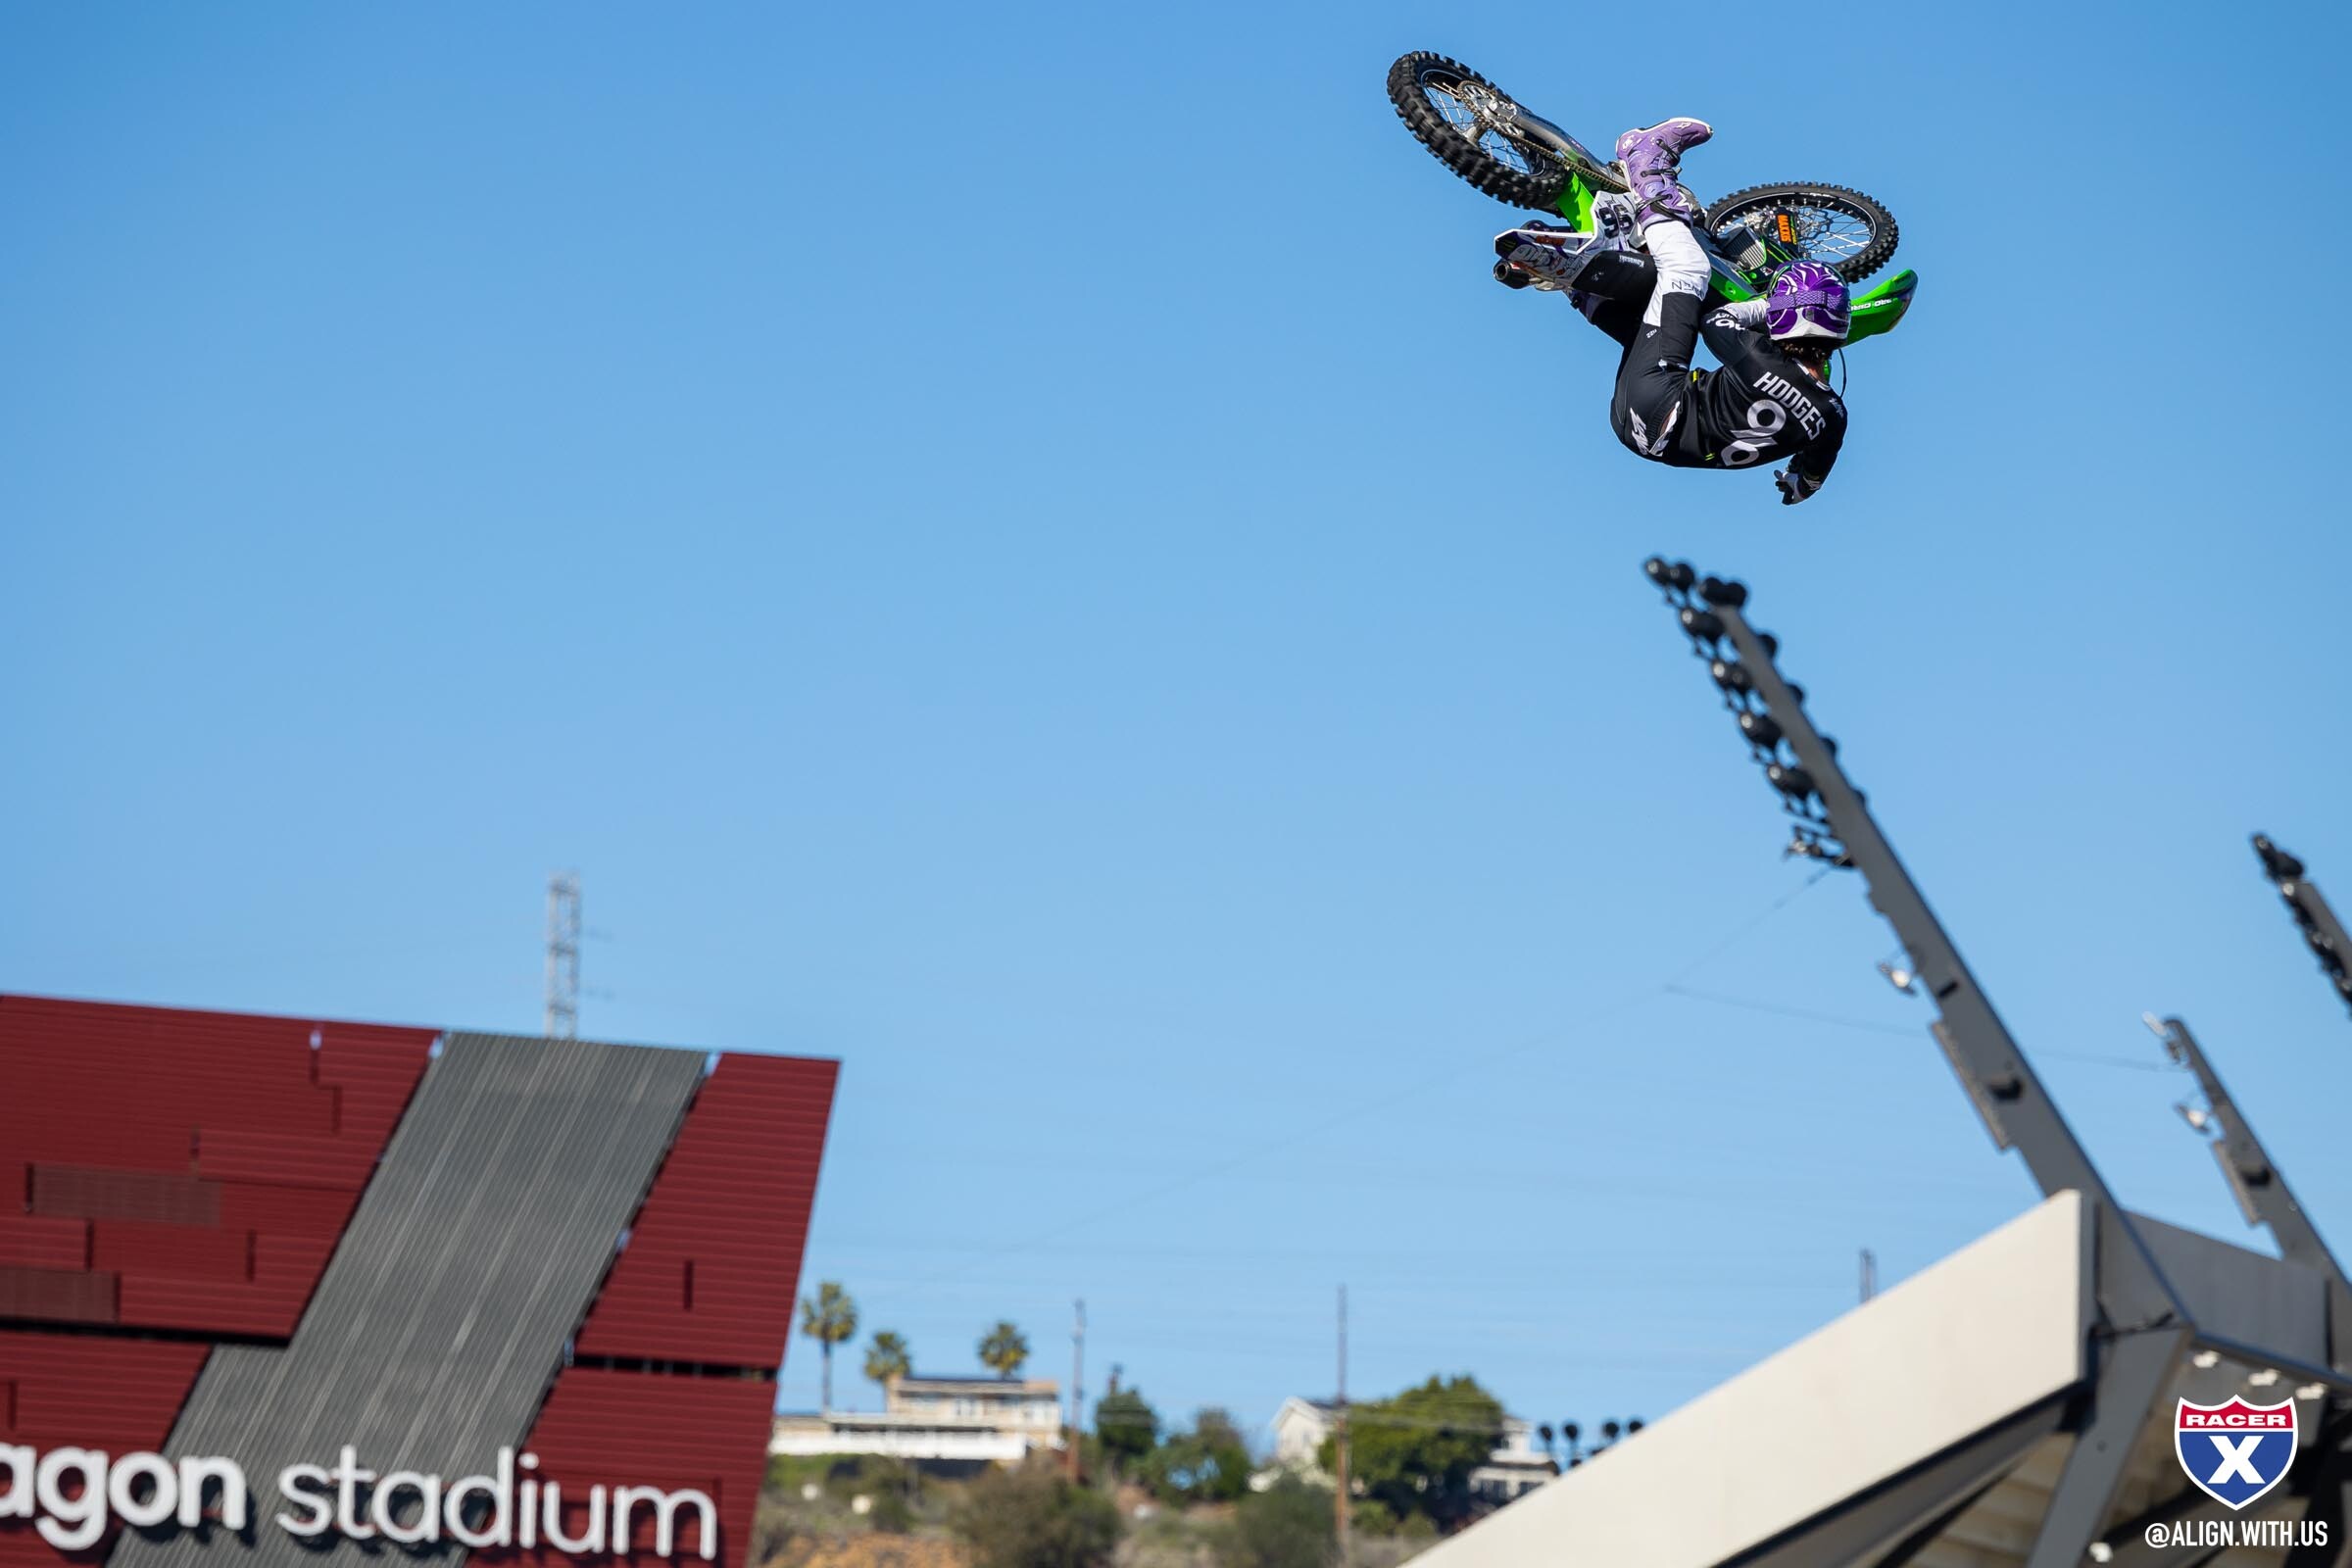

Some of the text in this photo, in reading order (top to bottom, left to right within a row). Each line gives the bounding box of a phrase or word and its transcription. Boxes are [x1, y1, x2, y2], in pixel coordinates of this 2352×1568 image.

[1777, 214, 1791, 243] MAXXIS
[1720, 399, 1787, 466] 96
[1752, 371, 1827, 441] HODGES
[275, 1446, 716, 1560] stadium
